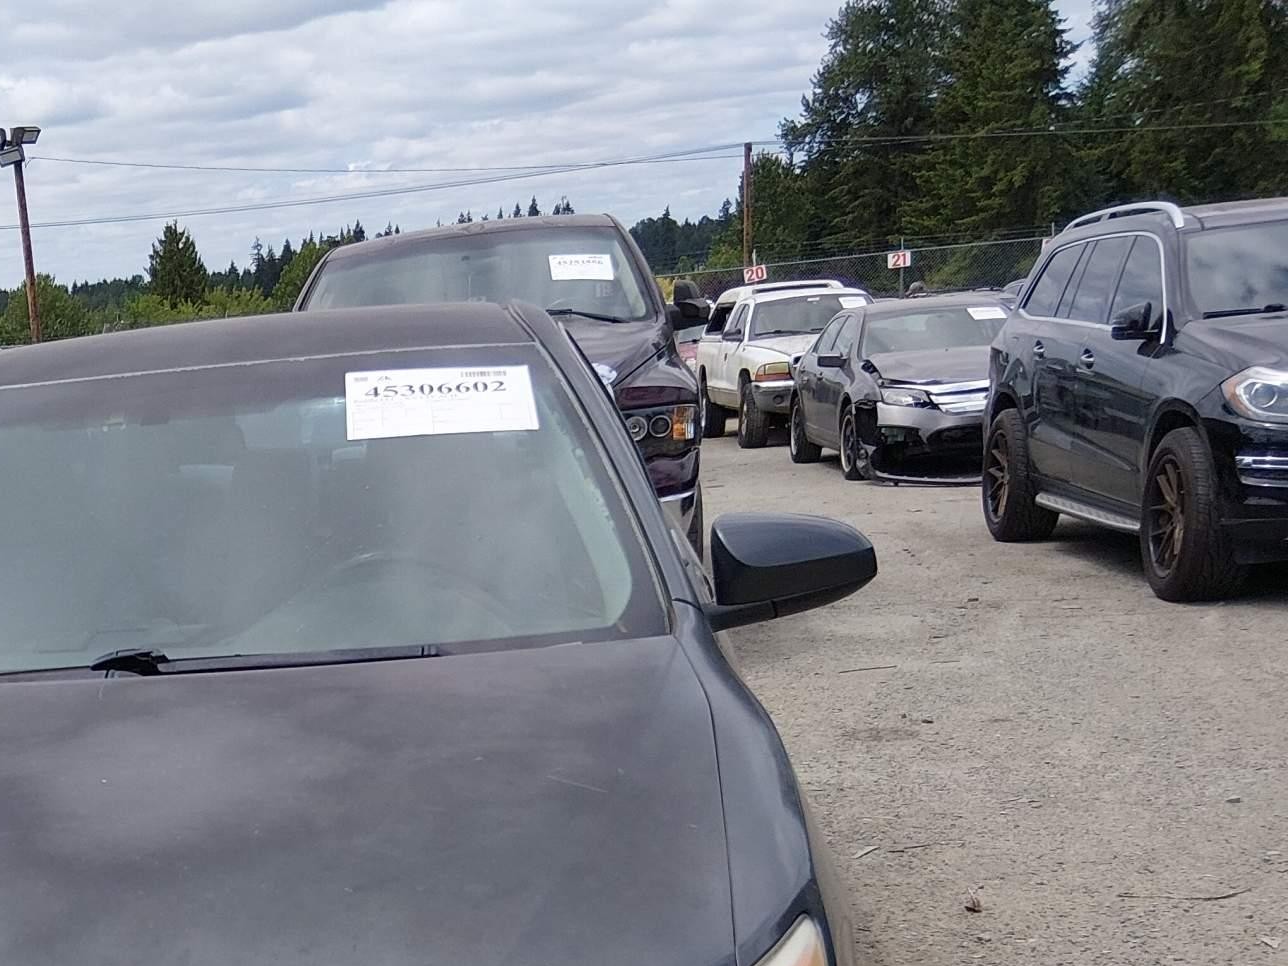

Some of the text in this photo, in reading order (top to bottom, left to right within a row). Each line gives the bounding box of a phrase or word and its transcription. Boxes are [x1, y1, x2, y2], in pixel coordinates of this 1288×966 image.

[892, 253, 907, 267] 21
[745, 266, 765, 282] 20
[364, 380, 508, 398] 45306602
